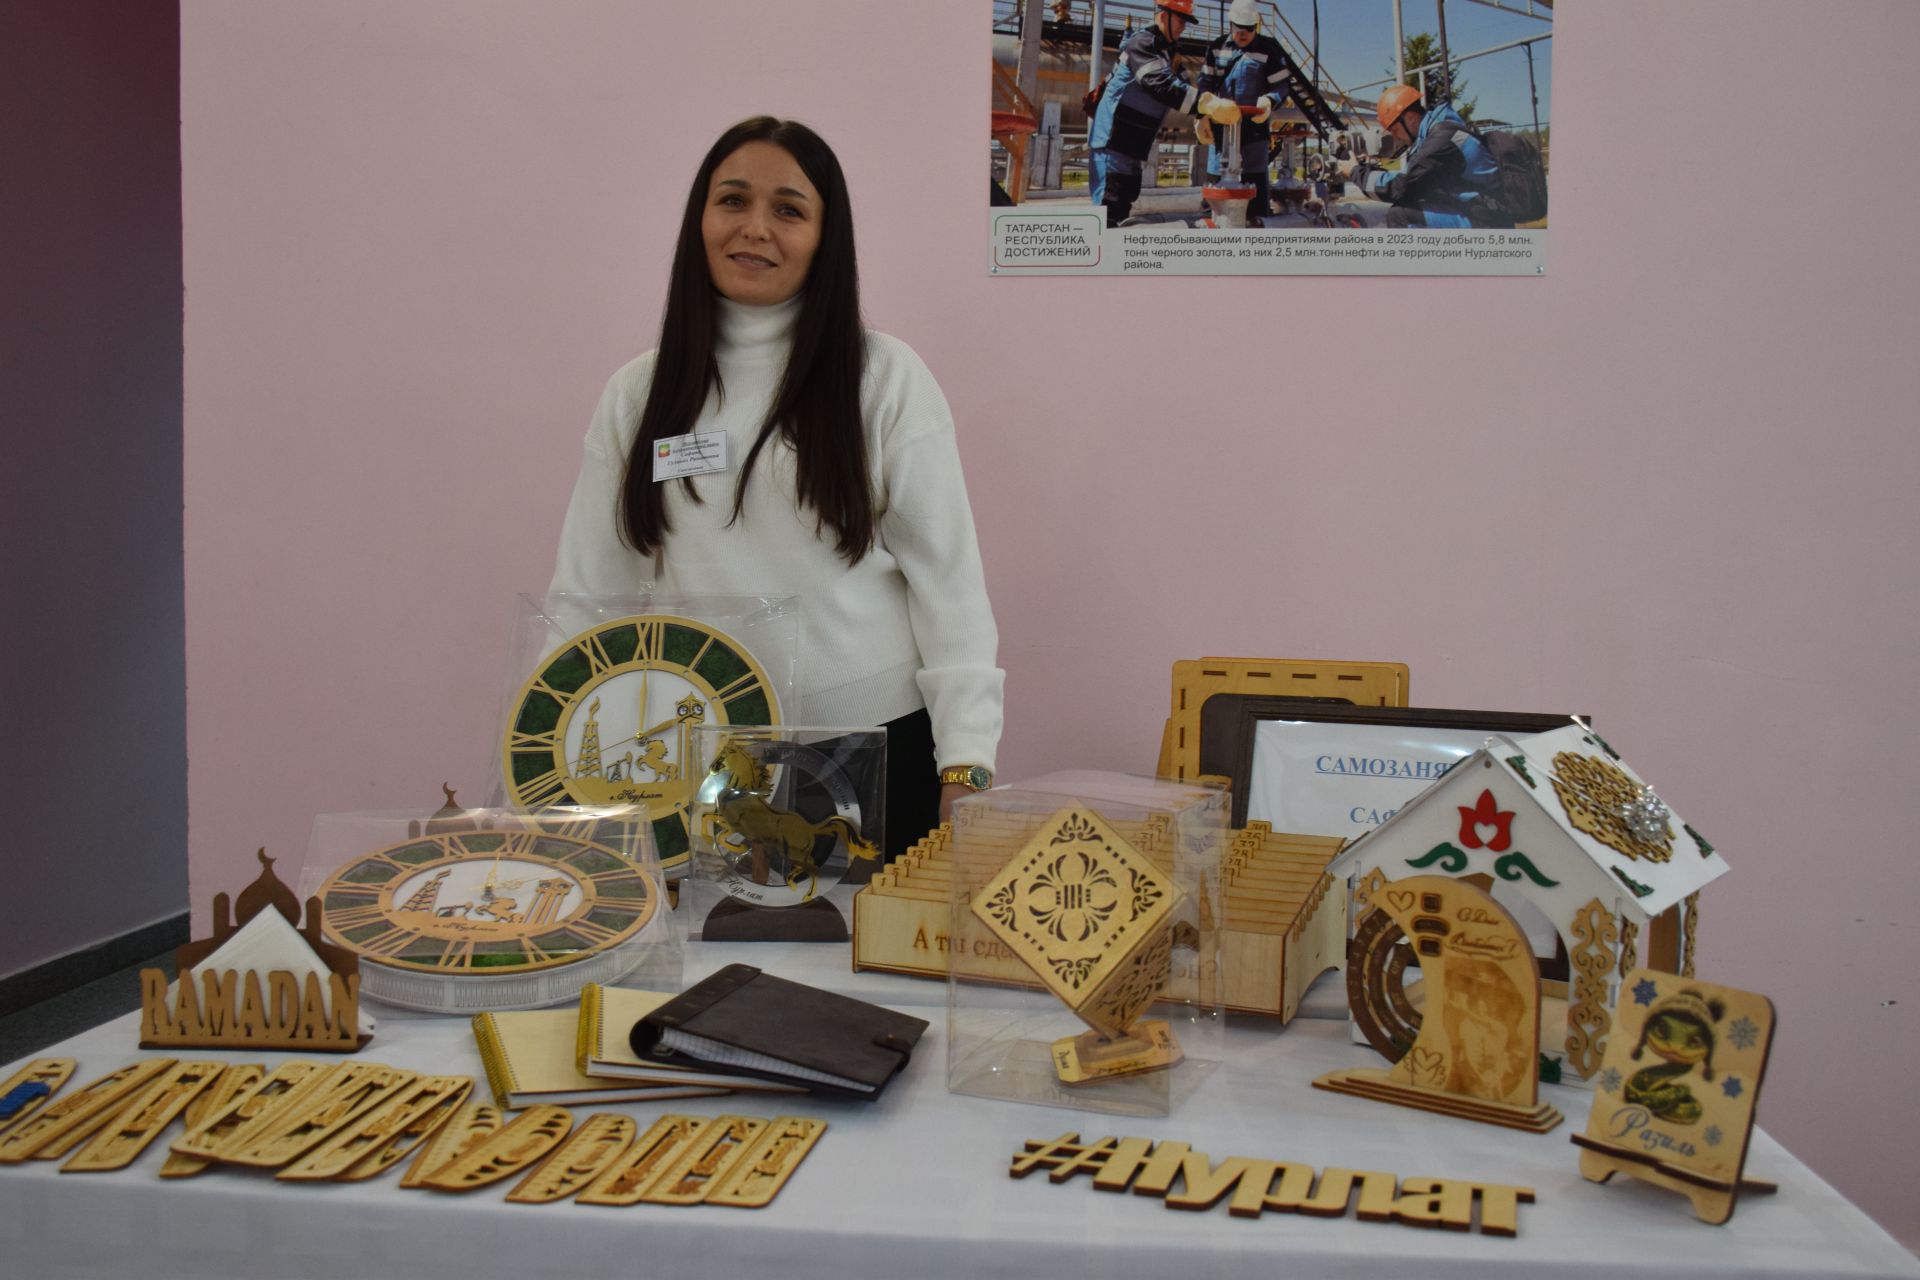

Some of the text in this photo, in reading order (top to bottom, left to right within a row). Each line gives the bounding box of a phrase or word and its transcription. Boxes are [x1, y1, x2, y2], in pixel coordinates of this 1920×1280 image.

[1005, 223, 1070, 233] ТАТАРСТАН
[1005, 235, 1086, 245] РЕСПУБЛИКА
[1123, 234, 1534, 246] Нефтедобывающими предприятиями района в 2023 году добыто 5,8 млн.
[1004, 245, 1091, 258] ДОСТИЖЕНИЙ
[1124, 249, 1148, 257] тонн
[1151, 249, 1194, 258] черного
[1196, 249, 1236, 258] золота,
[1239, 249, 1251, 257] из
[1254, 249, 1272, 257] них
[1275, 247, 1292, 258] 2,5
[1345, 247, 1379, 260] нефти
[1383, 249, 1395, 257] на
[1399, 249, 1461, 259] территории
[1465, 247, 1532, 260] Нурлатского
[1124, 258, 1164, 270] района.
[1316, 755, 1455, 779] САМОЗАНЯ
[912, 927, 929, 950] А
[139, 967, 362, 1045] RAMADAN
[1009, 1131, 1536, 1239] #Нурлат
